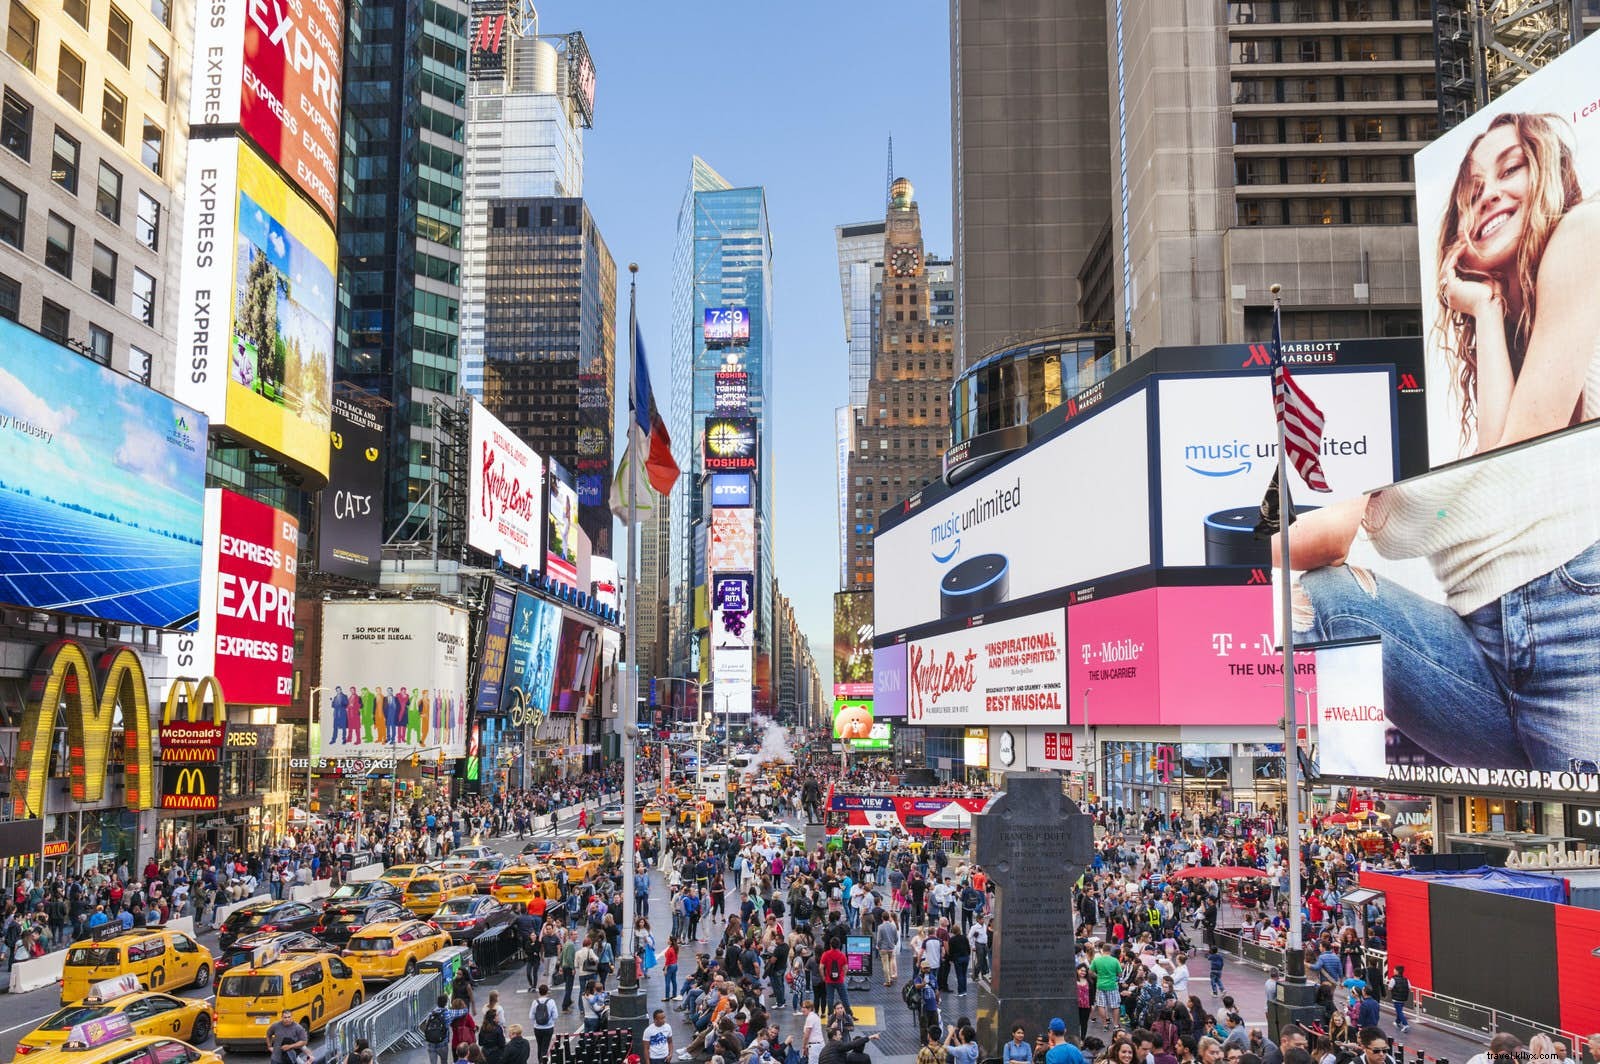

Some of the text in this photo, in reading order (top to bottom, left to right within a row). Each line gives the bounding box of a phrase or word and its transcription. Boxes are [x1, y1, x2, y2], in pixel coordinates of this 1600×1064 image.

[243, 64, 297, 136] EXPRESS
[196, 168, 217, 268] EXPRESS
[711, 311, 743, 324] 7:39
[191, 289, 211, 384] EXPRESS
[348, 403, 363, 416] BACK
[363, 411, 376, 421] AND
[350, 412, 366, 425] THAN
[12, 415, 53, 444] Industry
[1185, 440, 1250, 460] music
[706, 458, 756, 467] TOSHIBA
[482, 440, 534, 522] Kinky Boots
[334, 490, 371, 519] CATS
[931, 477, 1021, 545] music unlimited
[220, 533, 281, 569] EXPRESS
[217, 571, 296, 630] EXPRE
[216, 633, 279, 662] EXPRESS
[988, 657, 1001, 669] AND
[1228, 664, 1253, 675] THE
[878, 669, 900, 693] SKIN
[910, 644, 977, 720] Kinky Boots
[1089, 667, 1136, 680] THE UN-CARRIER
[985, 695, 1010, 712] BEST
[1011, 692, 1062, 711] MUSICAL
[1324, 705, 1384, 722] #WeAllCa
[161, 729, 221, 738] McDonald's
[1060, 736, 1071, 746] UNI
[1387, 764, 1480, 785] AMERICAN
[1487, 768, 1552, 789] EAGLE
[1395, 812, 1432, 825] ANIM
[1000, 832, 1034, 841] FRANCIS
